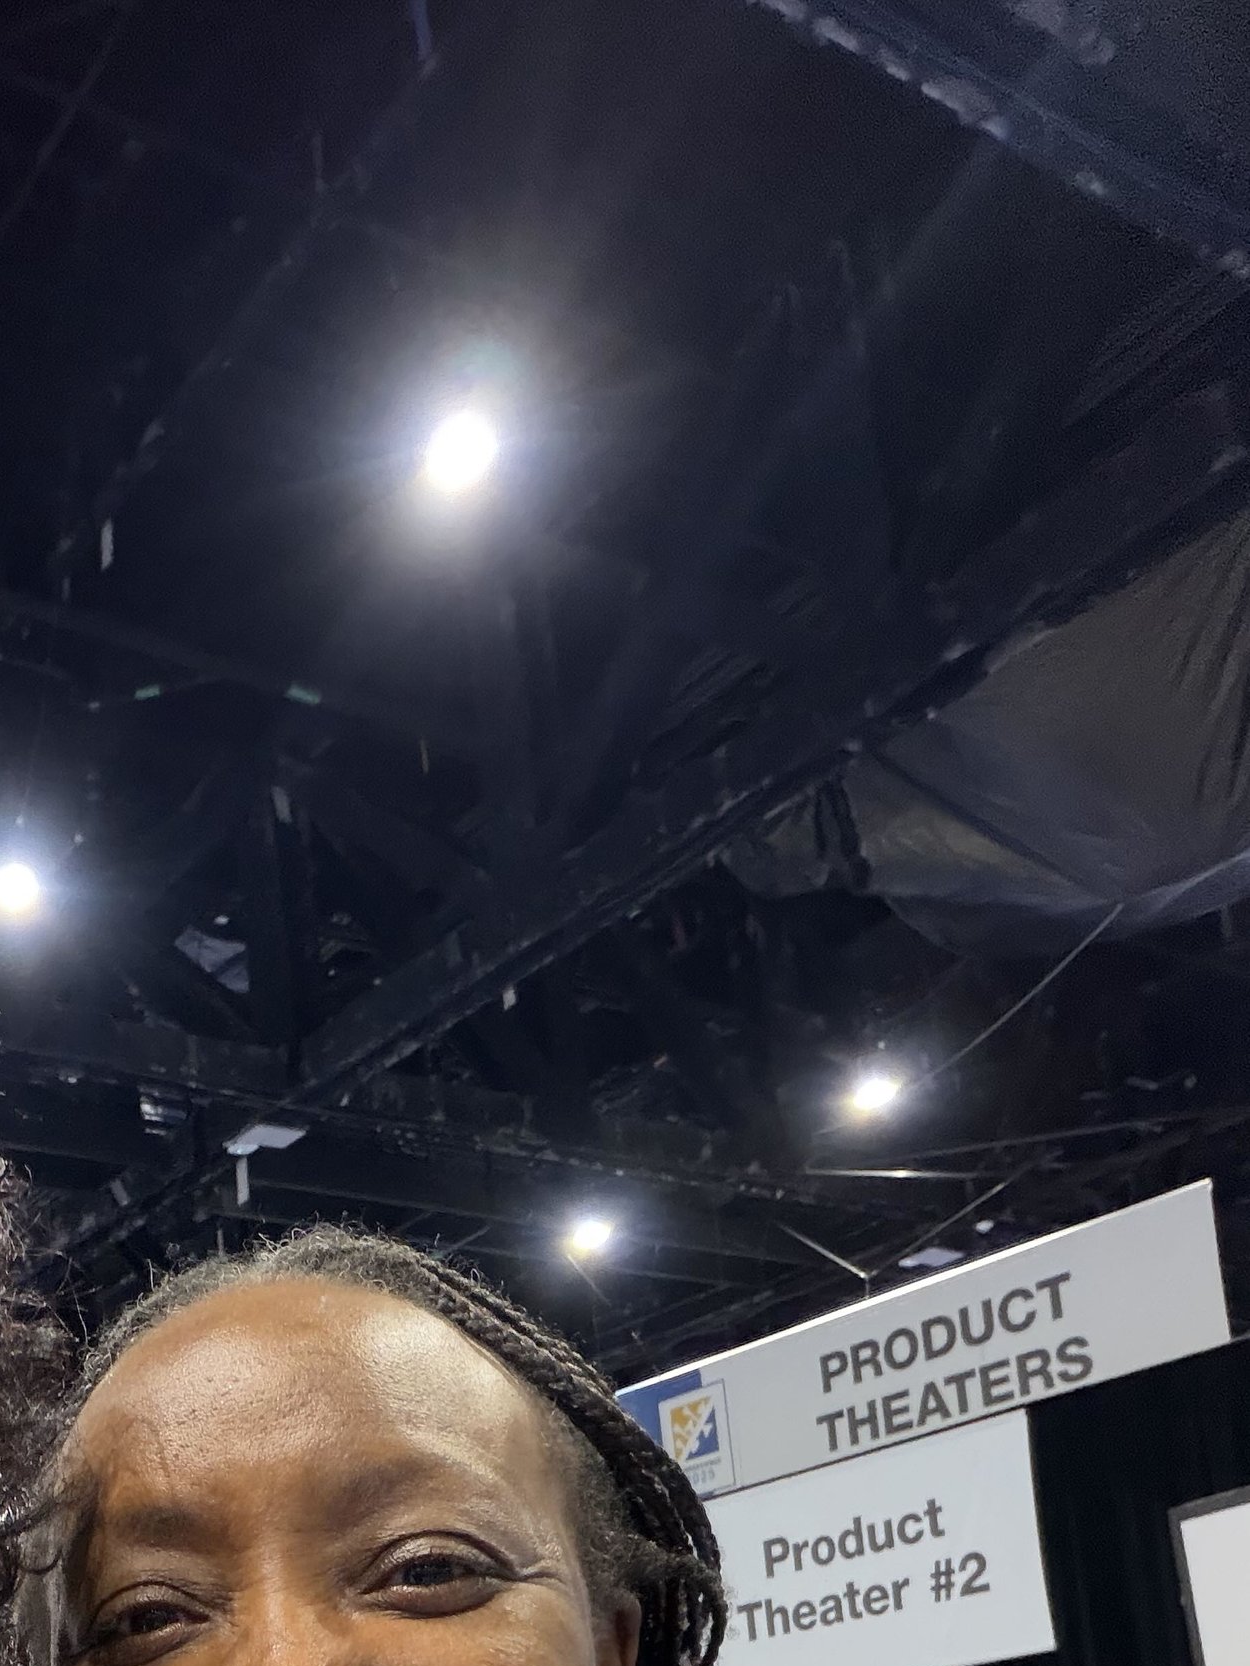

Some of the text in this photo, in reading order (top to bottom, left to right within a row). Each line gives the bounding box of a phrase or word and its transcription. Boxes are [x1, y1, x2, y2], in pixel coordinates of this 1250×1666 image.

[819, 1273, 1073, 1394] PRODUCT
[815, 1336, 1094, 1452] THEATERS
[762, 1498, 945, 1578] Product
[737, 1552, 991, 1642] Theater #2
